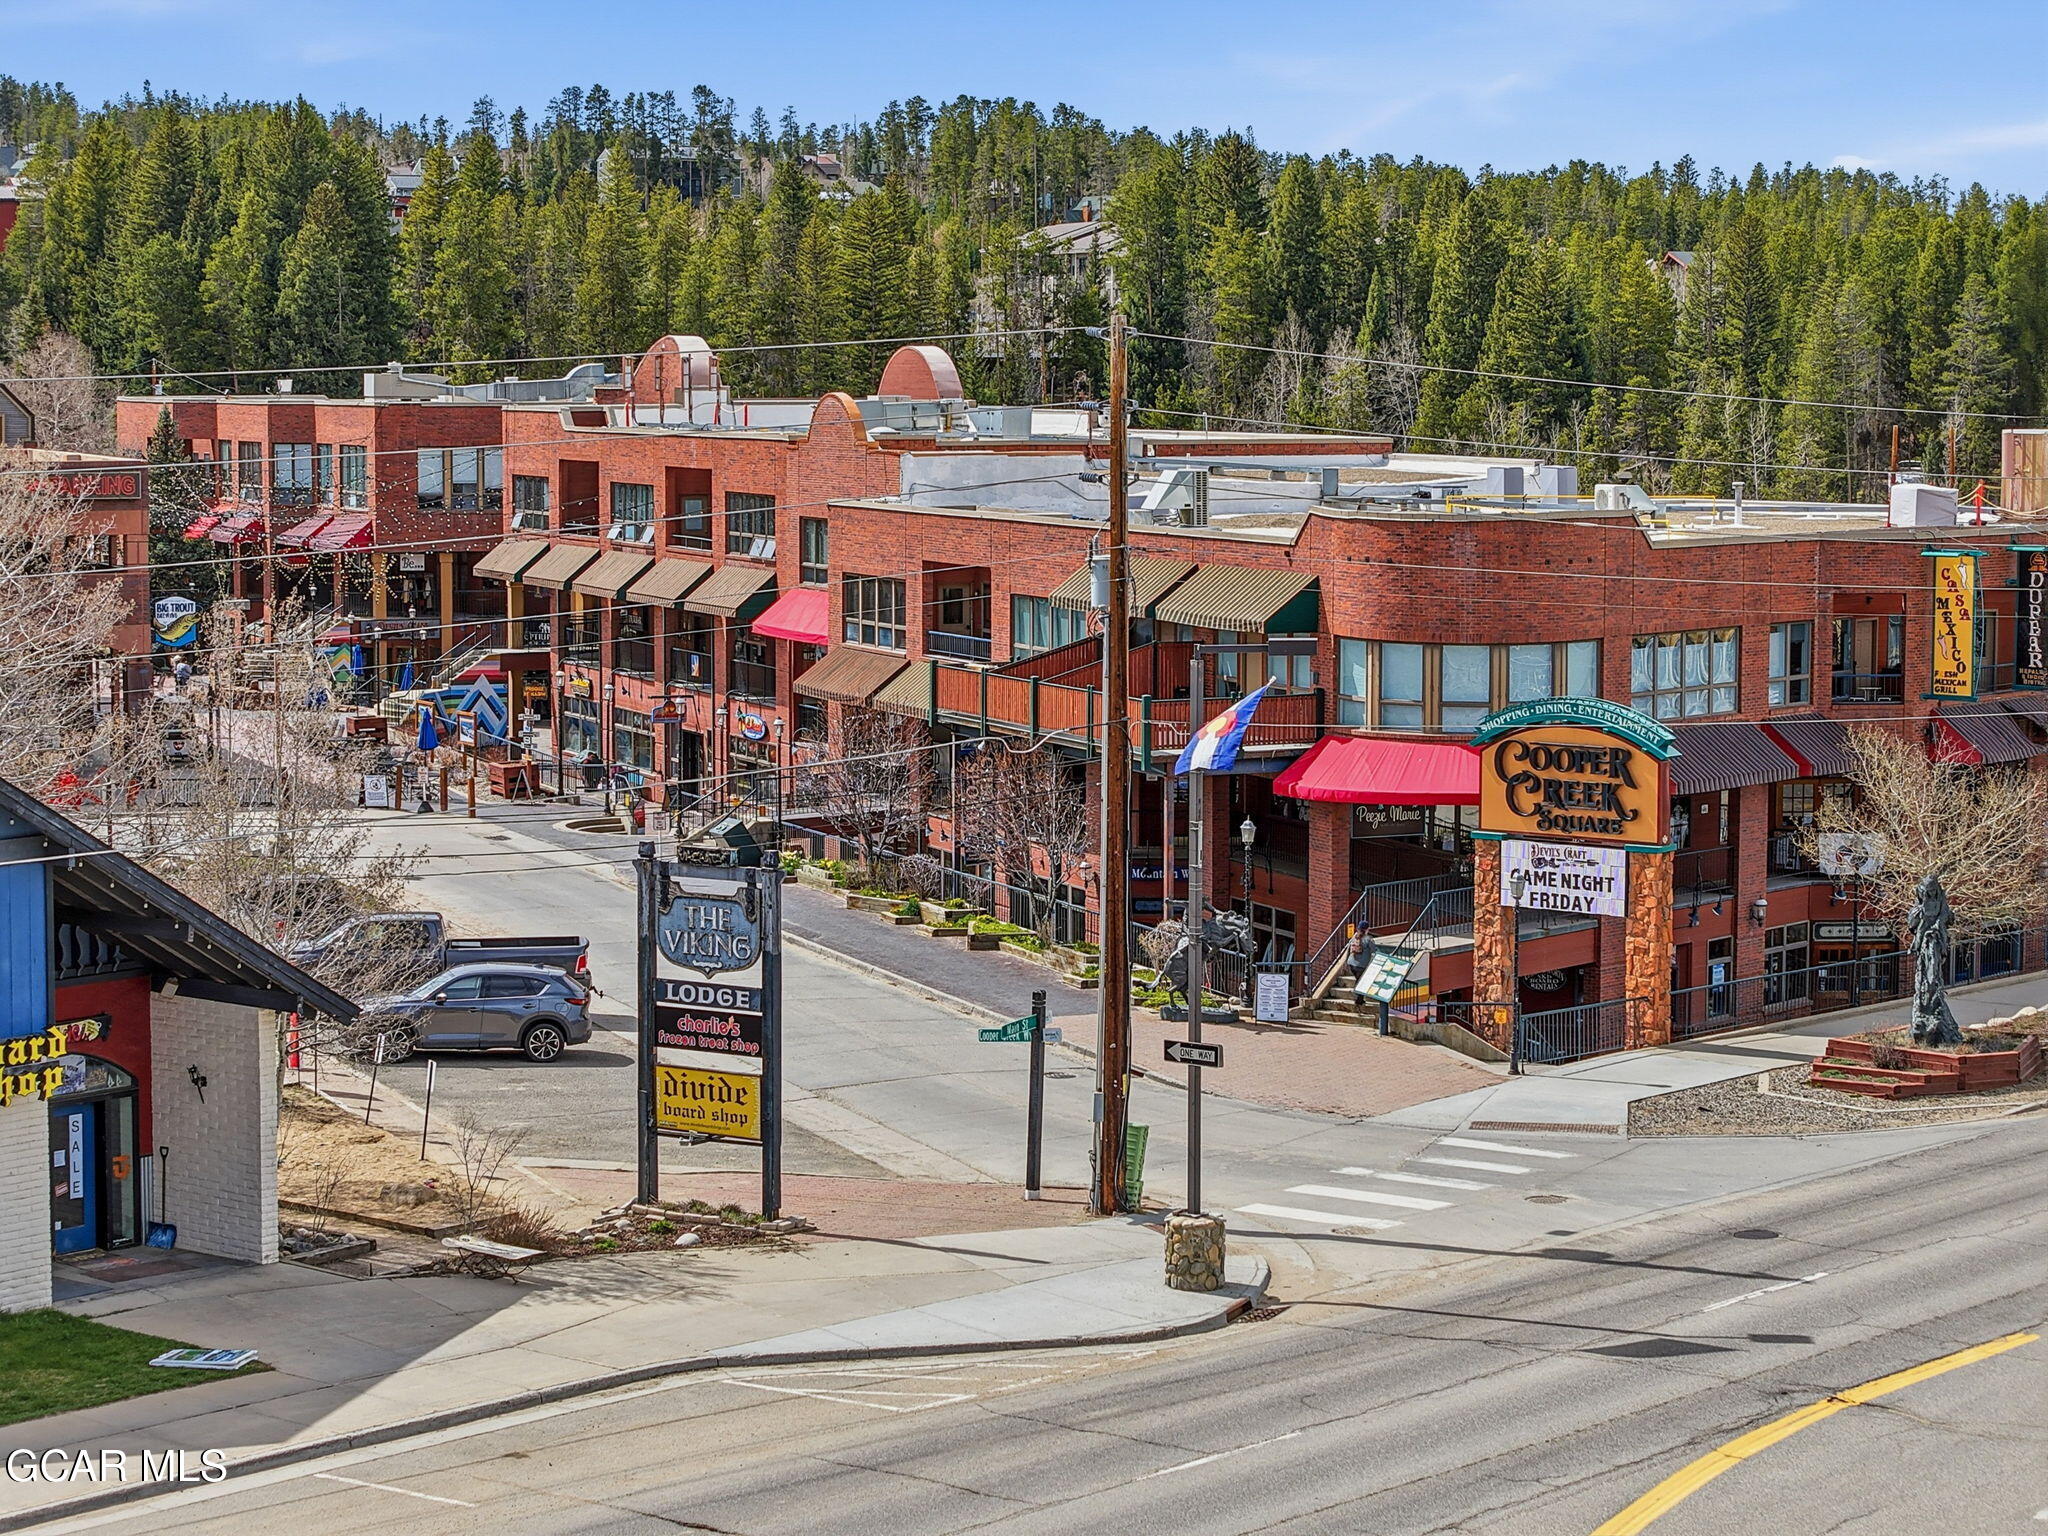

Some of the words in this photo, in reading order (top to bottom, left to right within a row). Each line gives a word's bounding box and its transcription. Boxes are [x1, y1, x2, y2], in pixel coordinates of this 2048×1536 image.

[156, 603, 169, 613] BIG
[170, 602, 195, 613] TROUT
[1934, 670, 1958, 679] FESH
[1934, 678, 1967, 687] MEXICAN
[1934, 686, 1958, 694] GRILL
[1481, 706, 1531, 733] SHOPPING
[1535, 702, 1572, 715] DINING
[1578, 704, 1661, 744] ENTERTAINMENT
[1494, 739, 1638, 790] COOPER
[1505, 770, 1639, 822] CREEK
[1389, 804, 1421, 822] Marie
[1536, 808, 1626, 836] SQUARE
[1561, 873, 1615, 893] NIGHT
[1529, 891, 1595, 912] FRIDAY
[684, 905, 732, 932] THE
[664, 929, 751, 960] VIKING
[664, 982, 750, 1009] LODGE
[677, 1013, 740, 1037] charlie's
[0, 1025, 68, 1066] ard
[657, 1030, 695, 1047] frozen
[698, 1035, 729, 1051] treat
[730, 1038, 759, 1056] shop
[1180, 1048, 1194, 1058] ONE
[1198, 1050, 1213, 1061] WAY
[0, 1064, 64, 1108] hop
[663, 1070, 749, 1106] divide
[663, 1101, 706, 1120] board
[711, 1107, 749, 1128] shop
[71, 1120, 80, 1194] SALE
